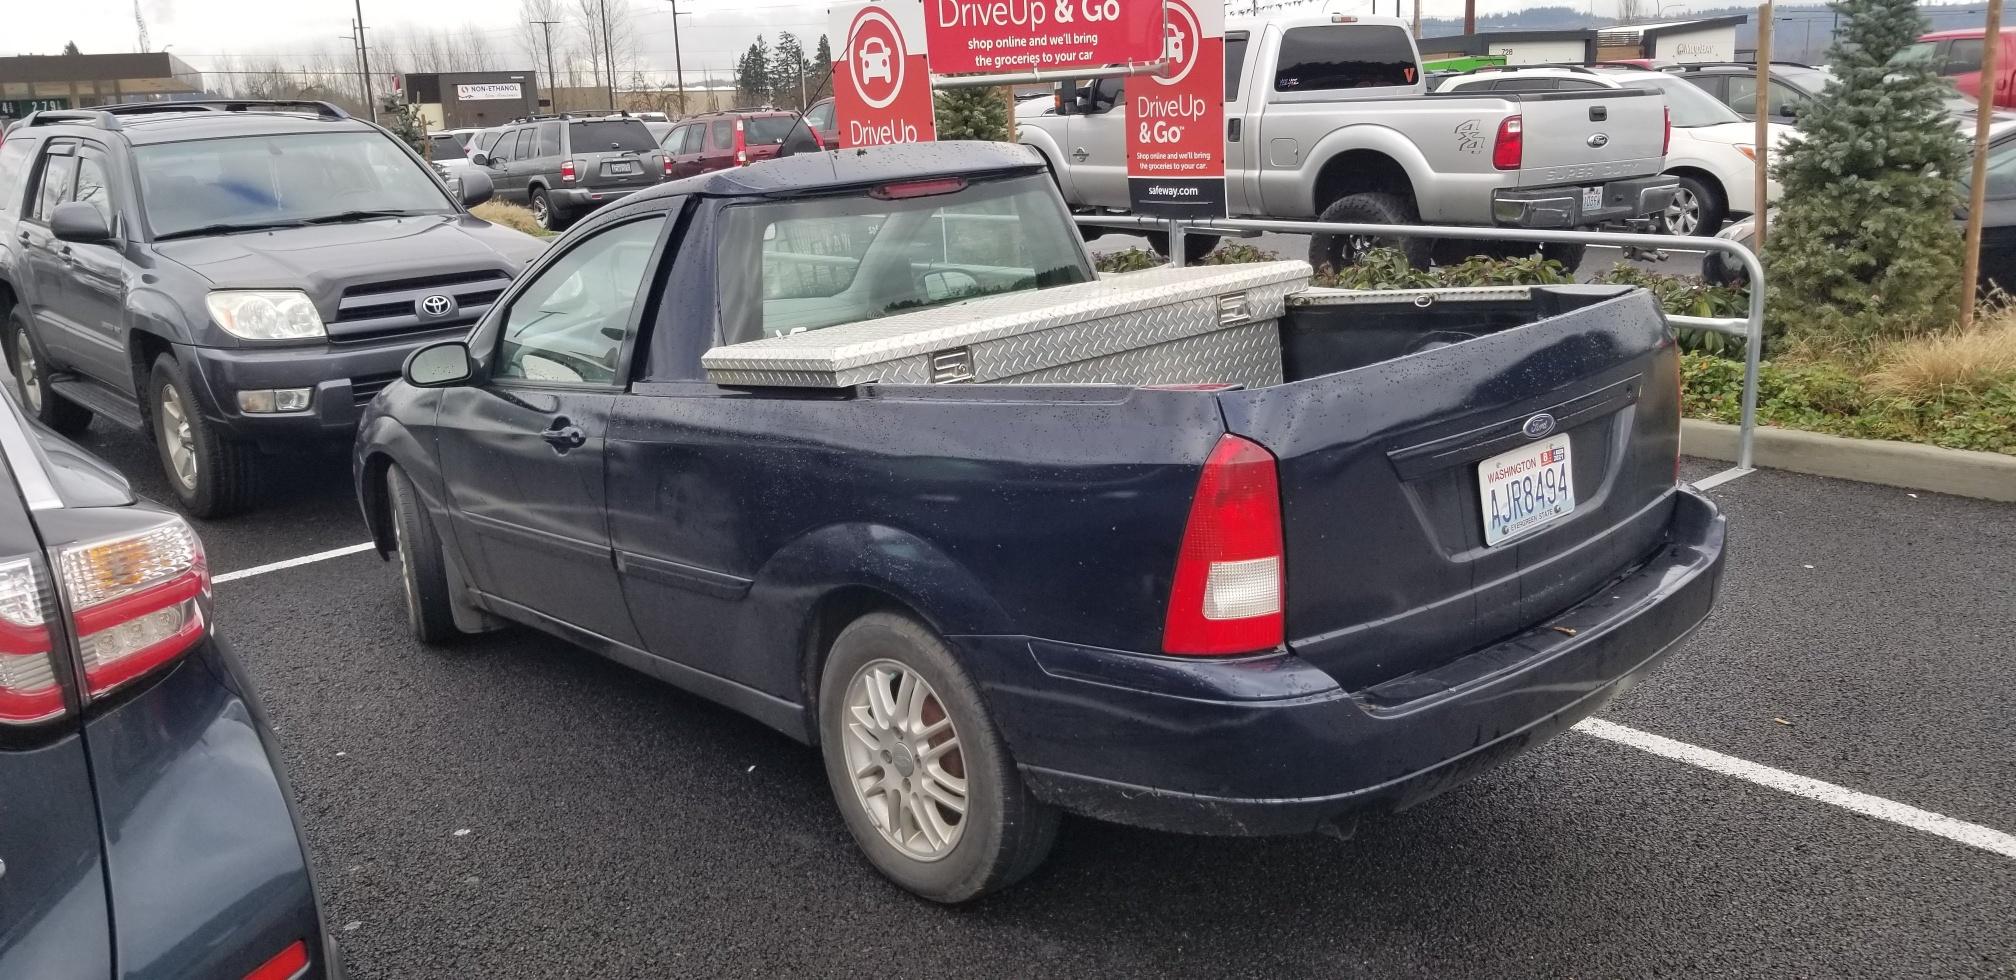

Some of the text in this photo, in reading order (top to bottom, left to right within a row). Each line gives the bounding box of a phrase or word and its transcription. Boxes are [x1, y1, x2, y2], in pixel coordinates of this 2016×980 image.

[937, 0, 1120, 32] DriveUp & Go
[968, 32, 1098, 51] shop online and we'll bring
[975, 51, 1093, 69] the groceries to your car
[471, 84, 519, 93] NON-ETHANOL
[1138, 93, 1206, 122] DriveUp
[1139, 121, 1151, 144] &
[1136, 151, 1211, 160] Shop online and we'll bring
[1140, 162, 1148, 170] the
[1149, 162, 1173, 171] groceries
[1180, 163, 1195, 171] your
[1546, 162, 1640, 181] SUPER DUTY
[1148, 185, 1199, 197] safeway.com
[1530, 417, 1549, 433] Ford
[1487, 457, 1537, 484] WASHINGTON
[1489, 462, 1568, 530] AJR8494
[1510, 508, 1553, 531] EVERGREEN STATE
